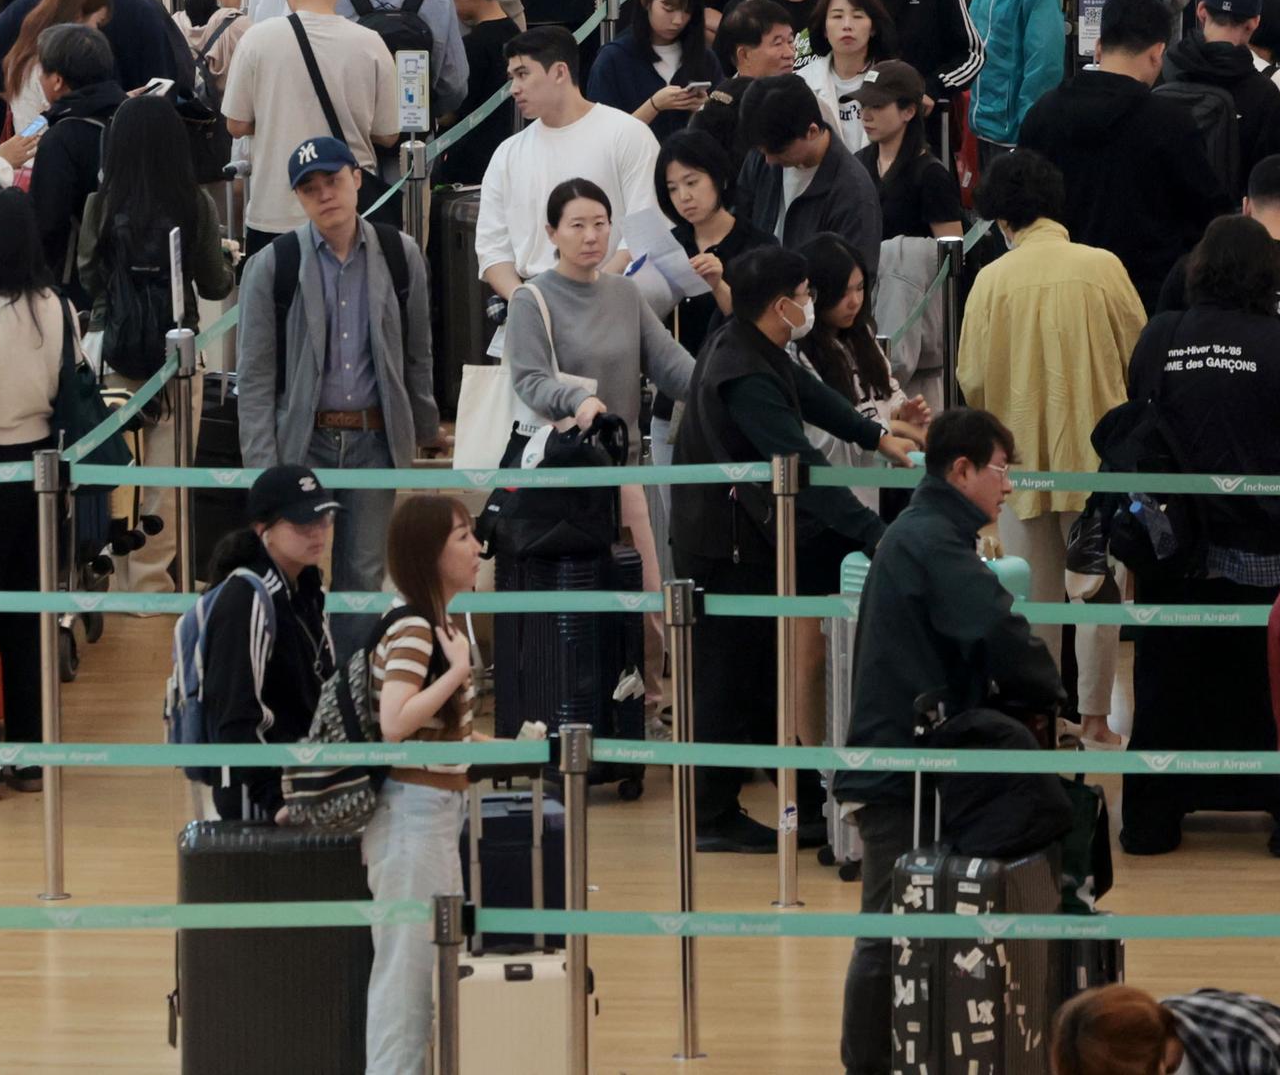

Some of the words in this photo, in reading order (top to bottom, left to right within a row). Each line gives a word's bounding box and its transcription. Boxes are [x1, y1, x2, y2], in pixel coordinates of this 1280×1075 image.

[1186, 359, 1204, 370] des
[1206, 357, 1257, 373] GARÇONS
[1020, 478, 1056, 490] Airport
[1243, 482, 1280, 495] Incheon
[1159, 611, 1200, 624] Incheon
[1203, 611, 1240, 624] Airport
[323, 750, 364, 763] Incheon
[367, 750, 409, 763] Airport
[616, 747, 655, 760] Airport
[872, 757, 914, 770] Incheon
[916, 757, 958, 770] Airport
[1176, 758, 1219, 771] Incheon
[1222, 758, 1263, 771] Airport
